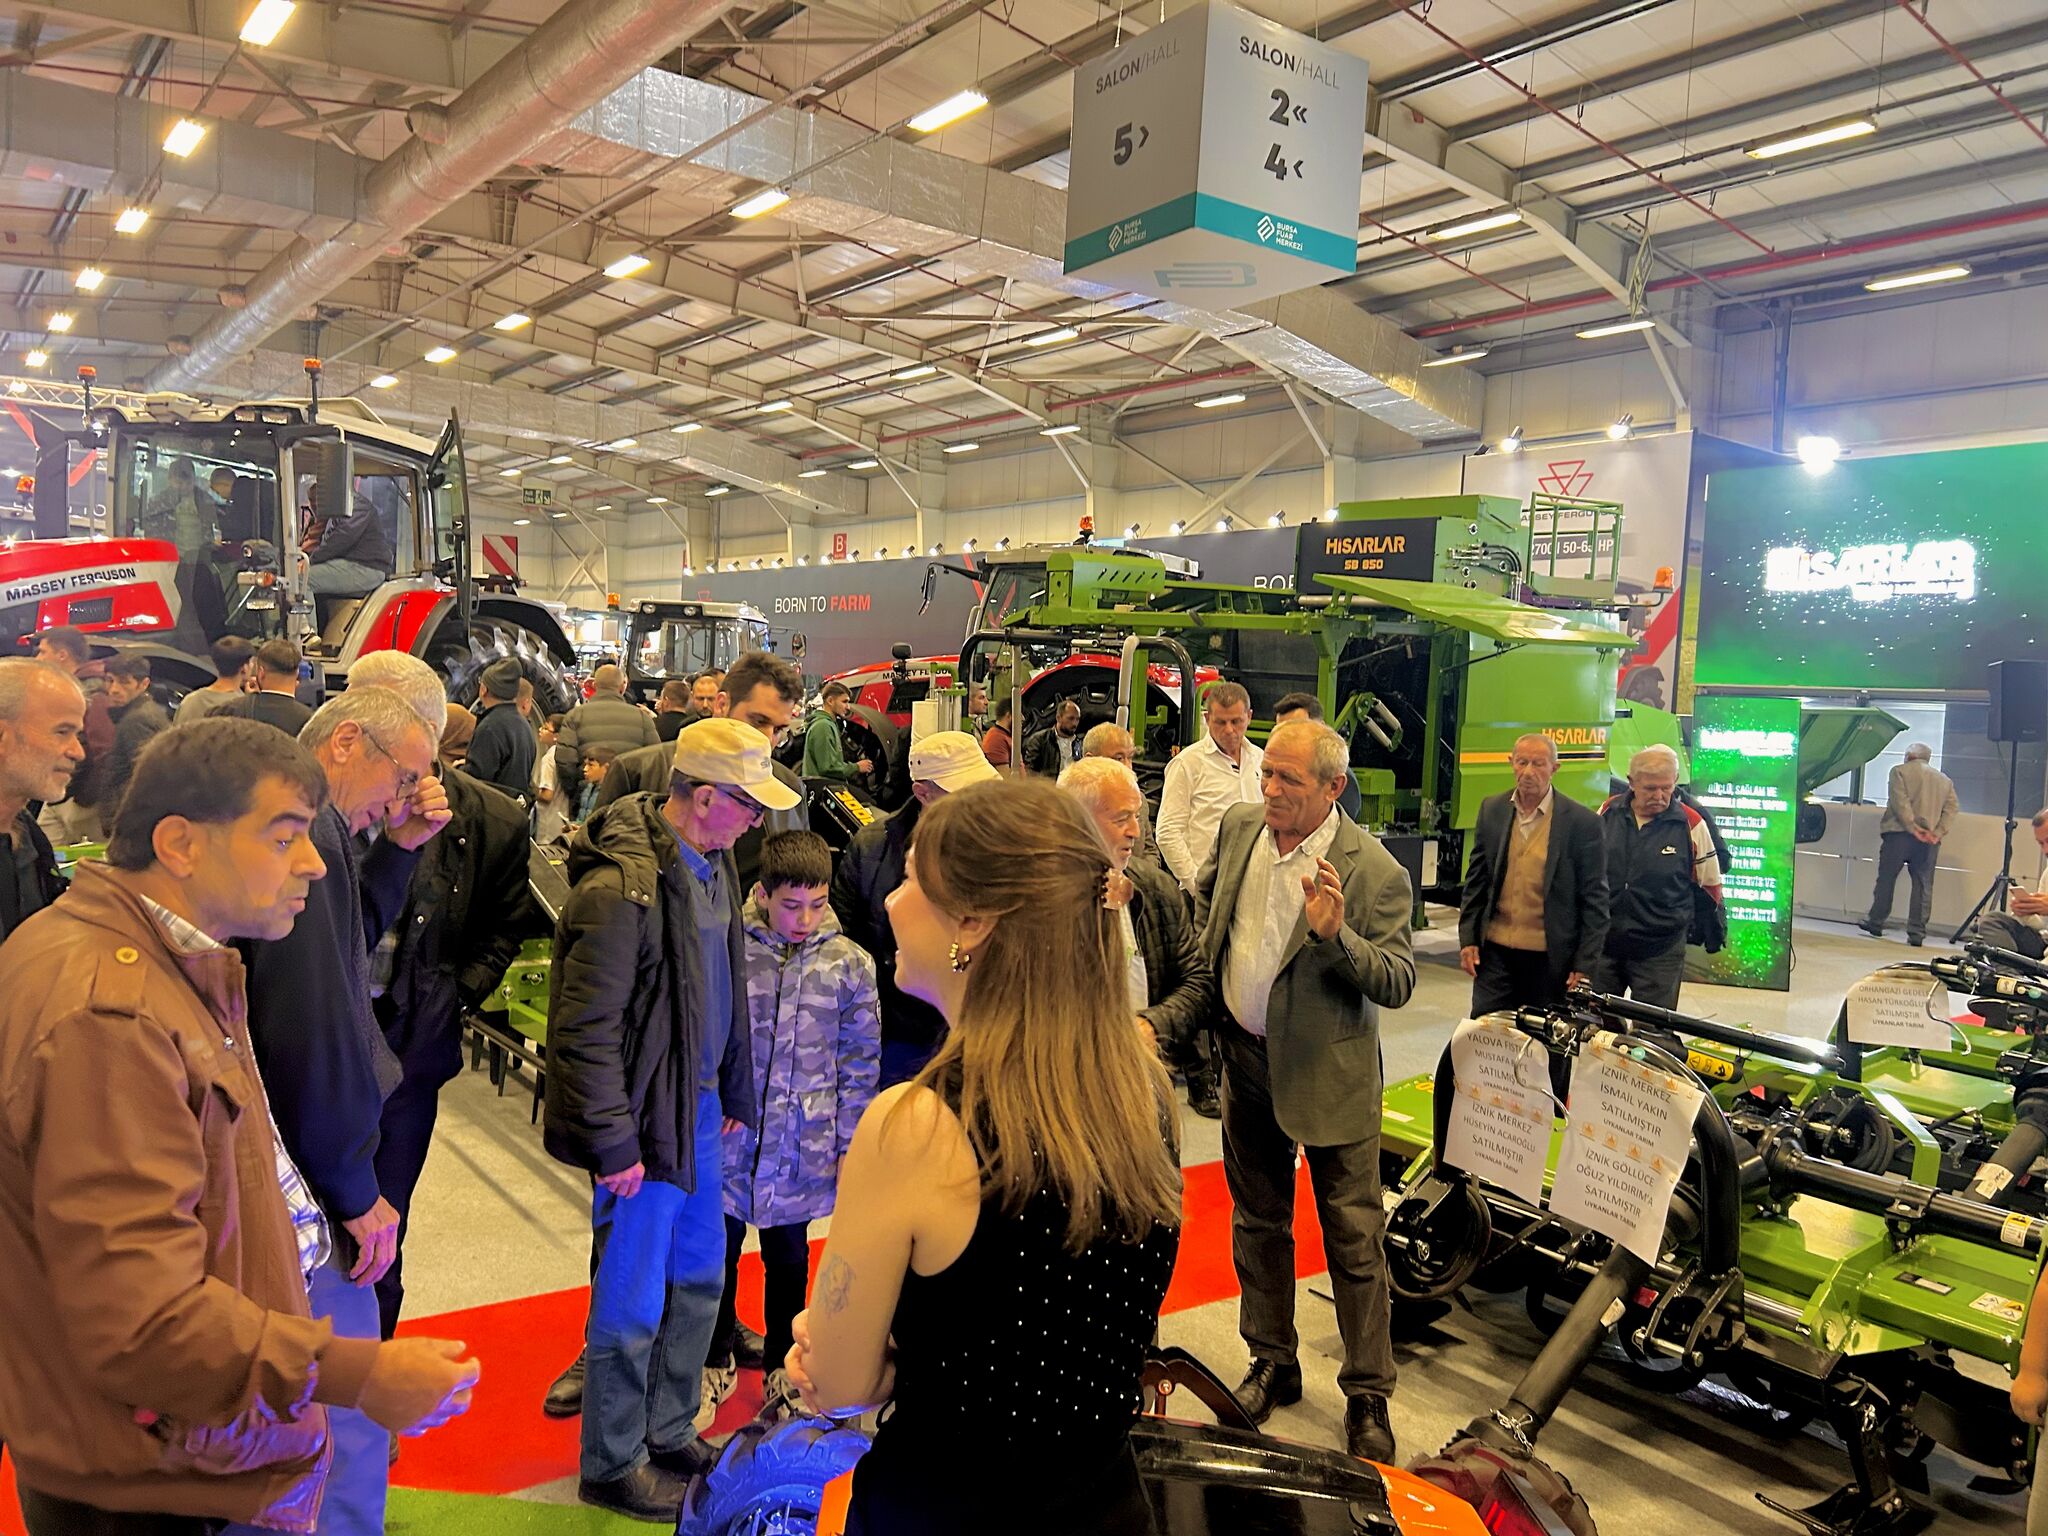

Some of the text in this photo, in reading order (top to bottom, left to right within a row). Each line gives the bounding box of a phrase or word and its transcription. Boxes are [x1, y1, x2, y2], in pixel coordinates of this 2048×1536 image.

[1240, 36, 1340, 89] SALON/HALL
[1276, 222, 1298, 234] BURSA
[1276, 229, 1294, 241] FUAR
[836, 535, 844, 552] B
[1598, 539, 1615, 552] HP
[1344, 558, 1384, 570] SB 850
[5, 567, 137, 602] MASSEY FERGUSON
[774, 593, 871, 614] BORN TO FARM
[1466, 1032, 1503, 1048] YALOVA
[1630, 1077, 1672, 1105] MERKEZ
[1601, 1101, 1662, 1137] SATILMIŞTIR
[1637, 1099, 1669, 1121] YAKIN
[1497, 1112, 1533, 1135] MERKEZ
[1603, 1118, 1655, 1147] UYKANLAR TARIM
[1471, 1134, 1525, 1165] SATILMIŞTIR
[1576, 1163, 1605, 1183] OĞUZ
[1612, 1159, 1656, 1187] GÖLLÜCE
[1584, 1184, 1641, 1218] SATILMIŞTIR
[1584, 1199, 1637, 1229] UYKANLAR TARIM
